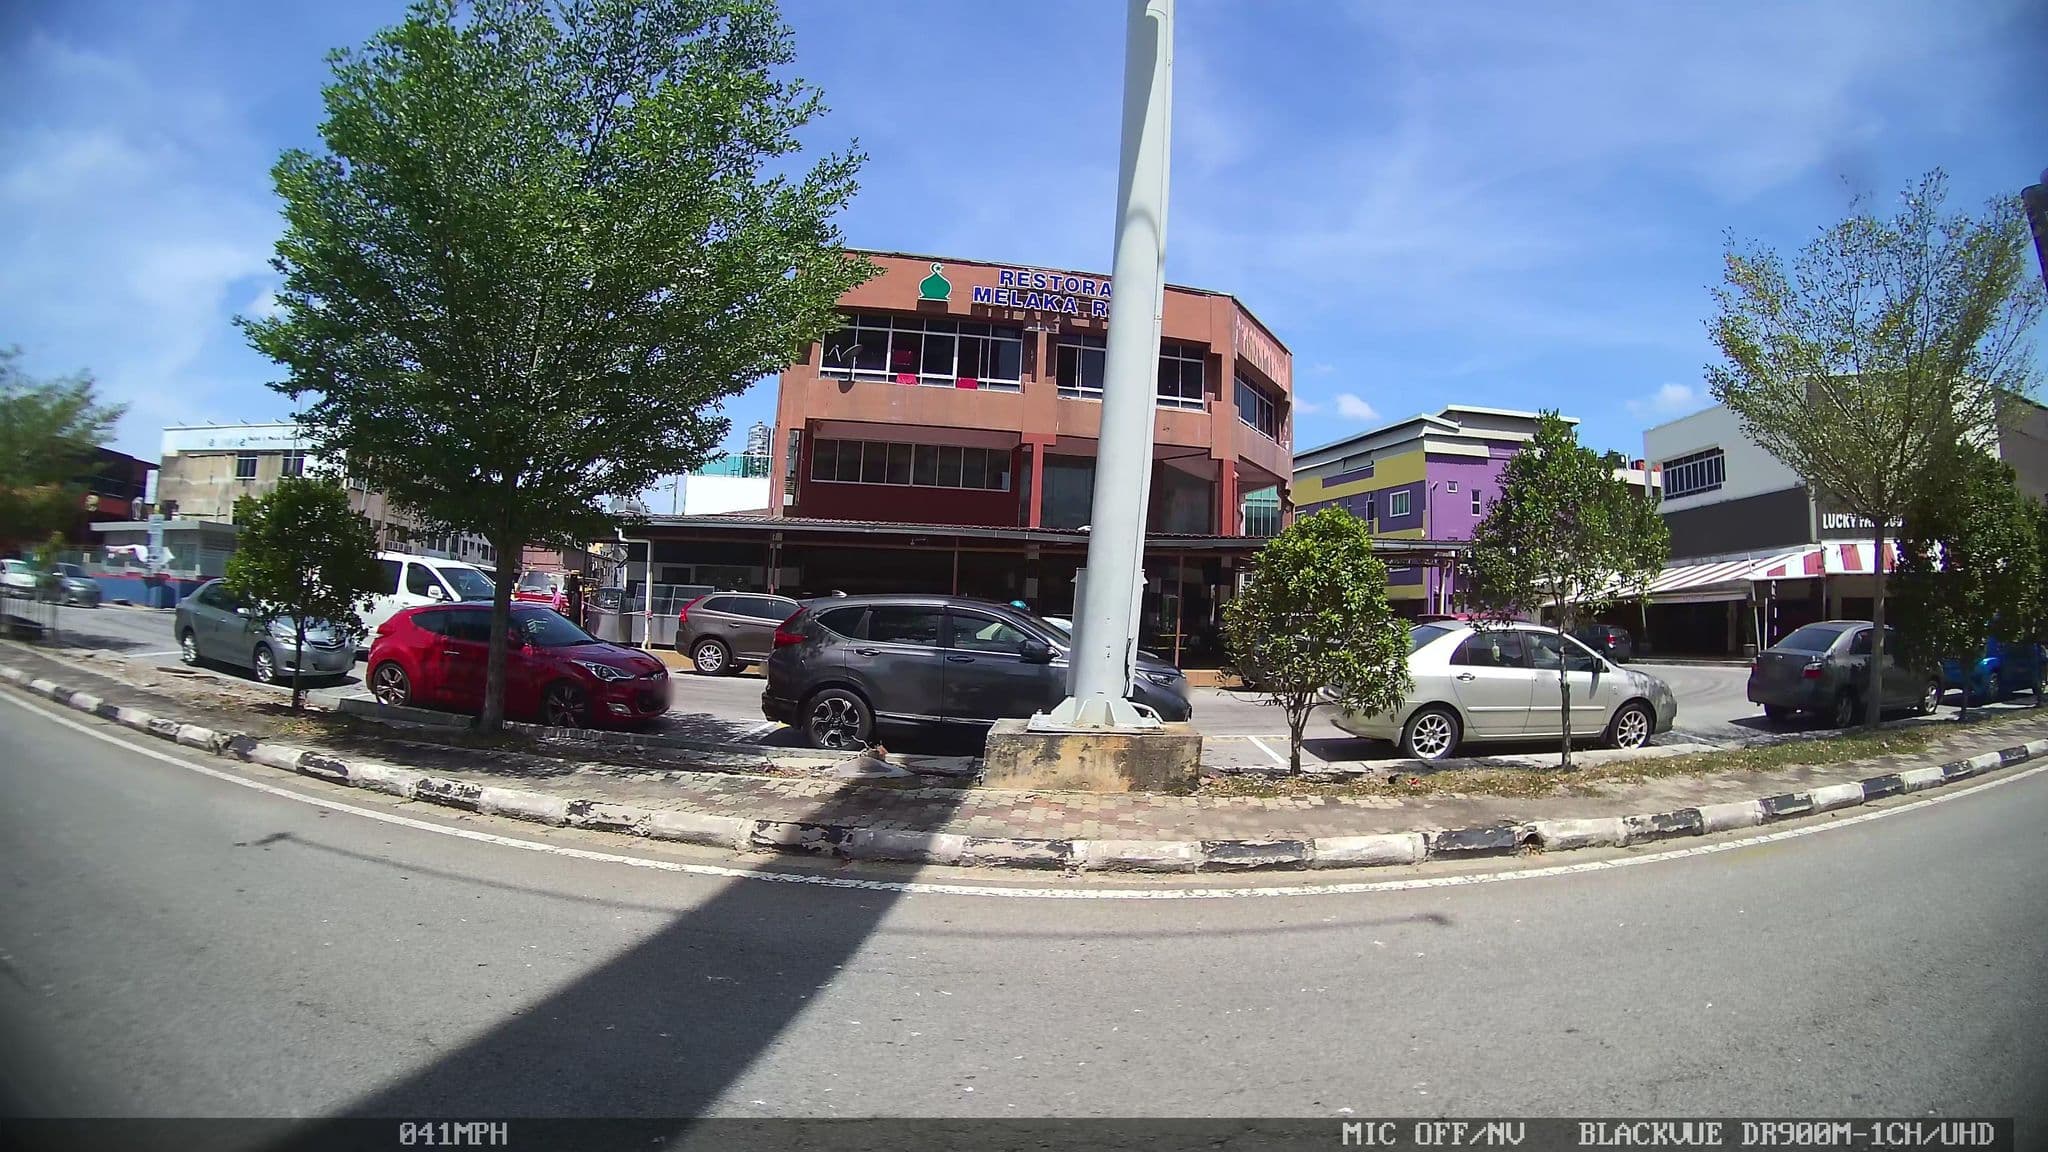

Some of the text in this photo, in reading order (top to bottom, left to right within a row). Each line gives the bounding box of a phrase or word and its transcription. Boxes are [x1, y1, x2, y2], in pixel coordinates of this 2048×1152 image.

[998, 268, 1112, 298] RESTORA
[973, 285, 1078, 314] MELAKA
[1822, 512, 1857, 529] LUCKY
